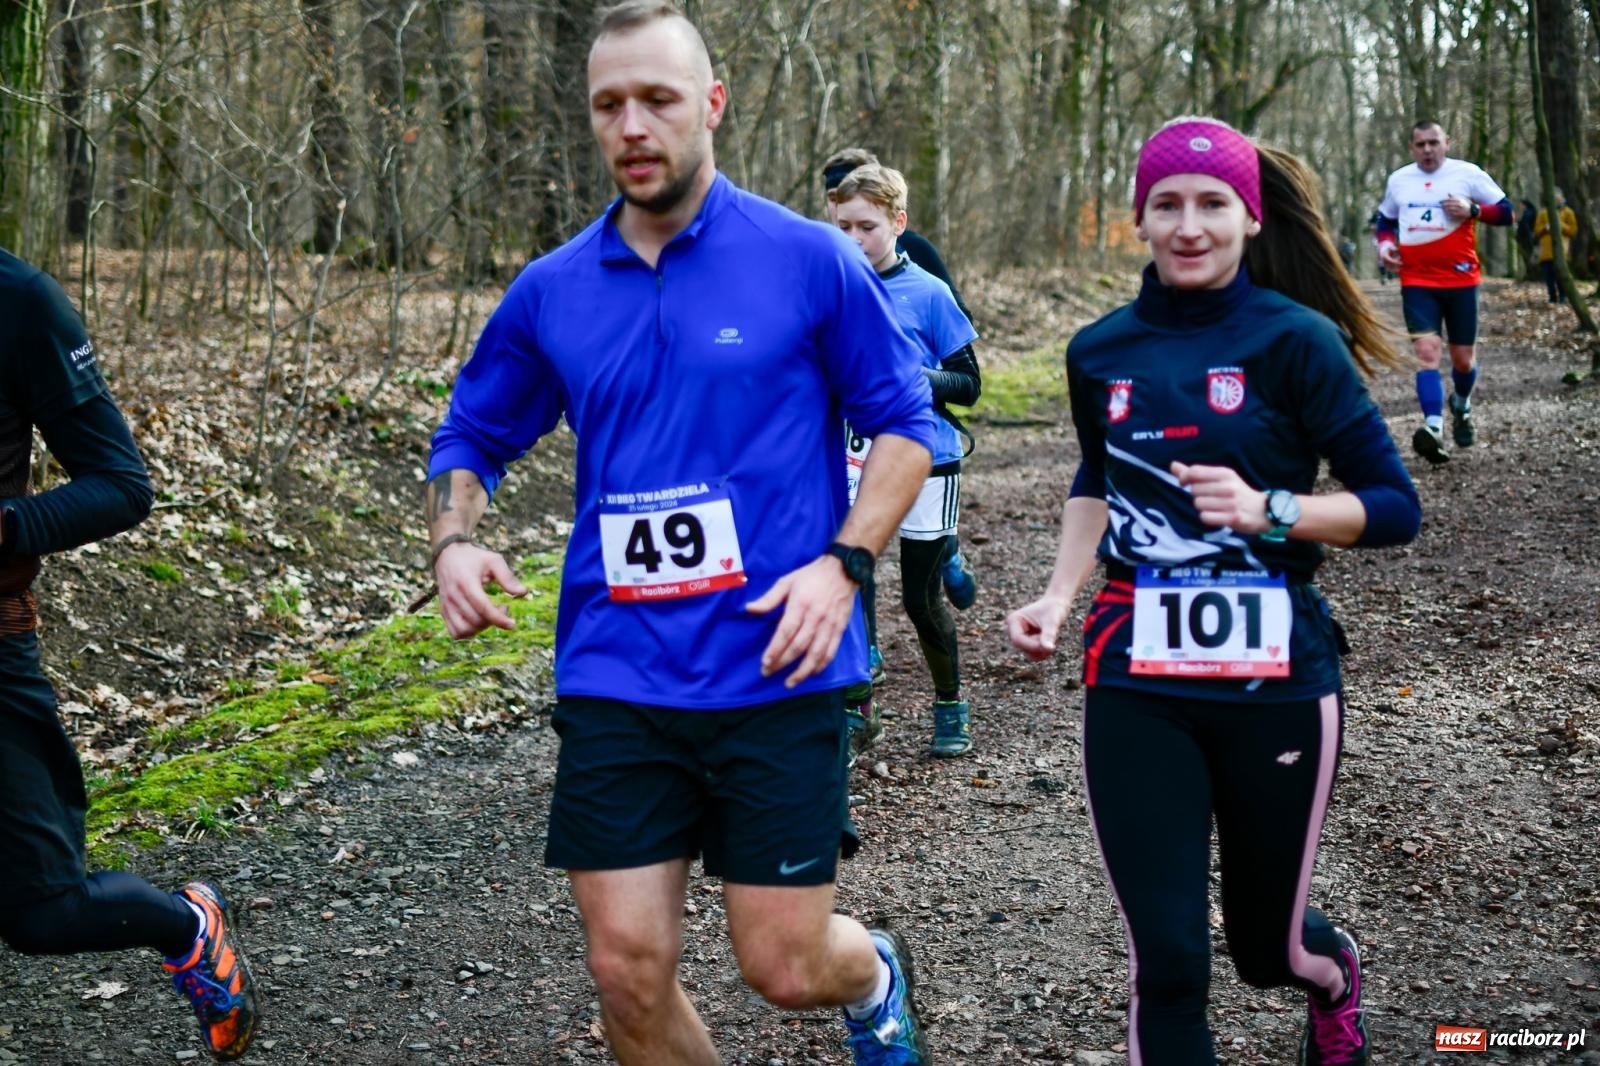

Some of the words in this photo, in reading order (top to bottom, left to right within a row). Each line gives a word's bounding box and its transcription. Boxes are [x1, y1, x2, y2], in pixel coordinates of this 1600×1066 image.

[1420, 209, 1432, 222] 4
[70, 344, 90, 362] ING
[617, 493, 636, 504] BIEG
[636, 482, 710, 502] TWARDZIELA
[625, 512, 706, 573] 49
[1160, 591, 1261, 649] 101
[1277, 751, 1302, 765] 4F
